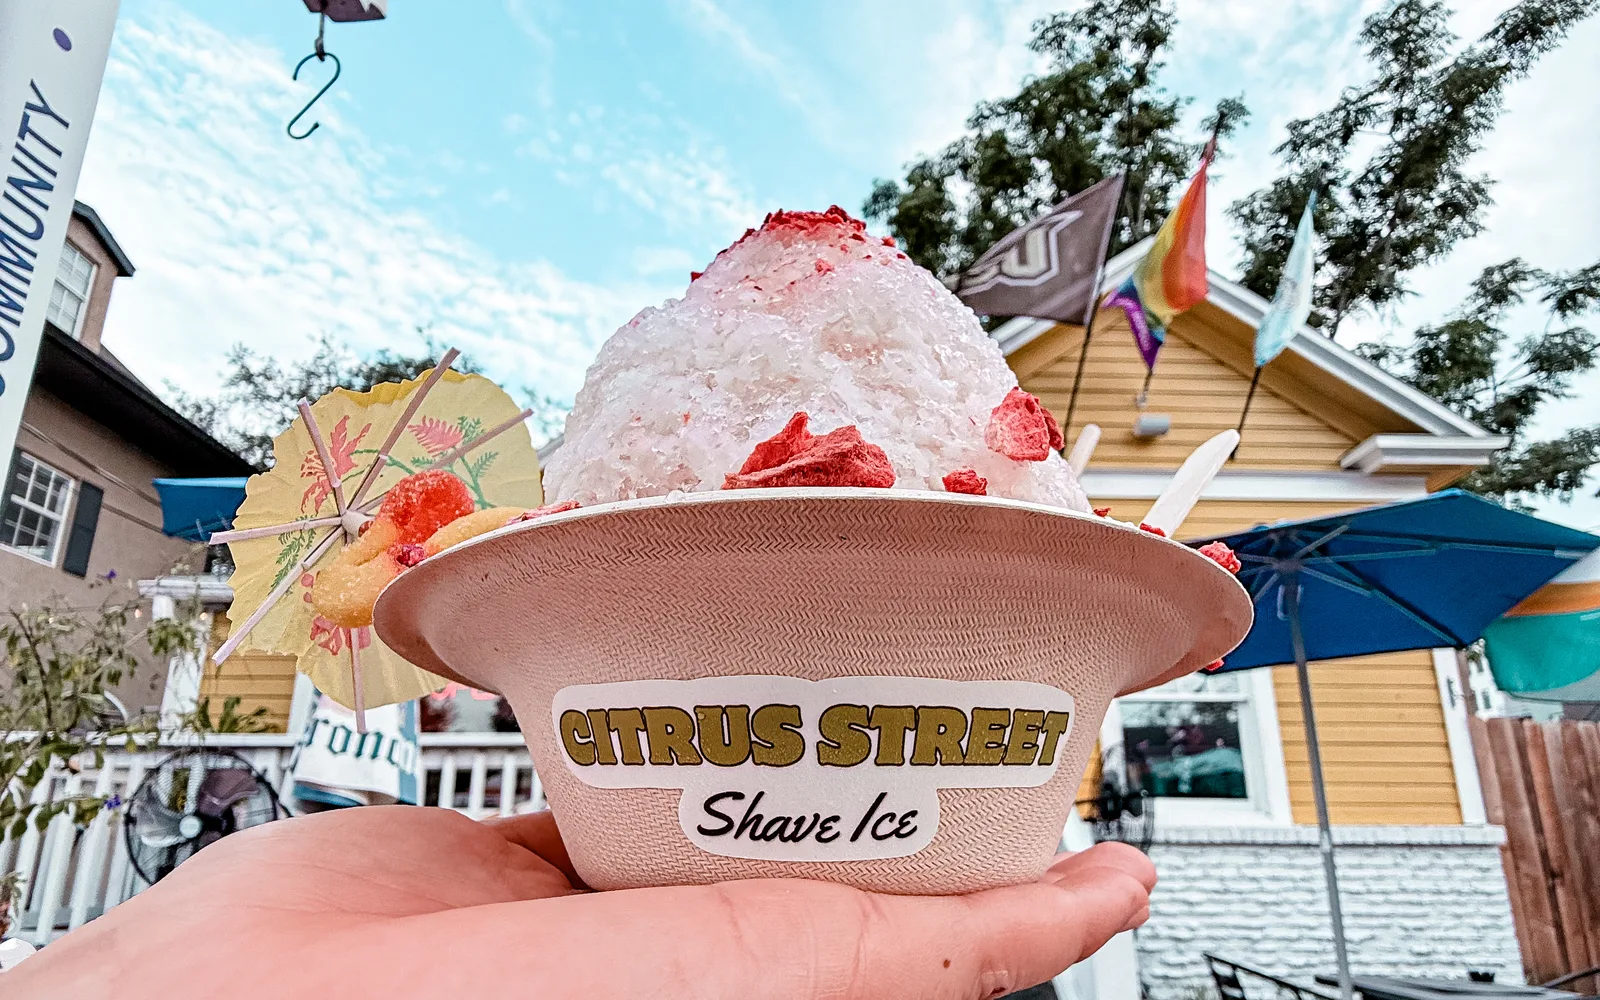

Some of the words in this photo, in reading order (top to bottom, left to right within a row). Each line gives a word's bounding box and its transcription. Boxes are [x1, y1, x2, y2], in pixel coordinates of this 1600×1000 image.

[0, 79, 70, 397] MMUNITY
[560, 704, 805, 767] CITRUS
[816, 704, 1070, 767] STREET
[697, 791, 840, 844] Shave
[849, 791, 918, 841] Ice
